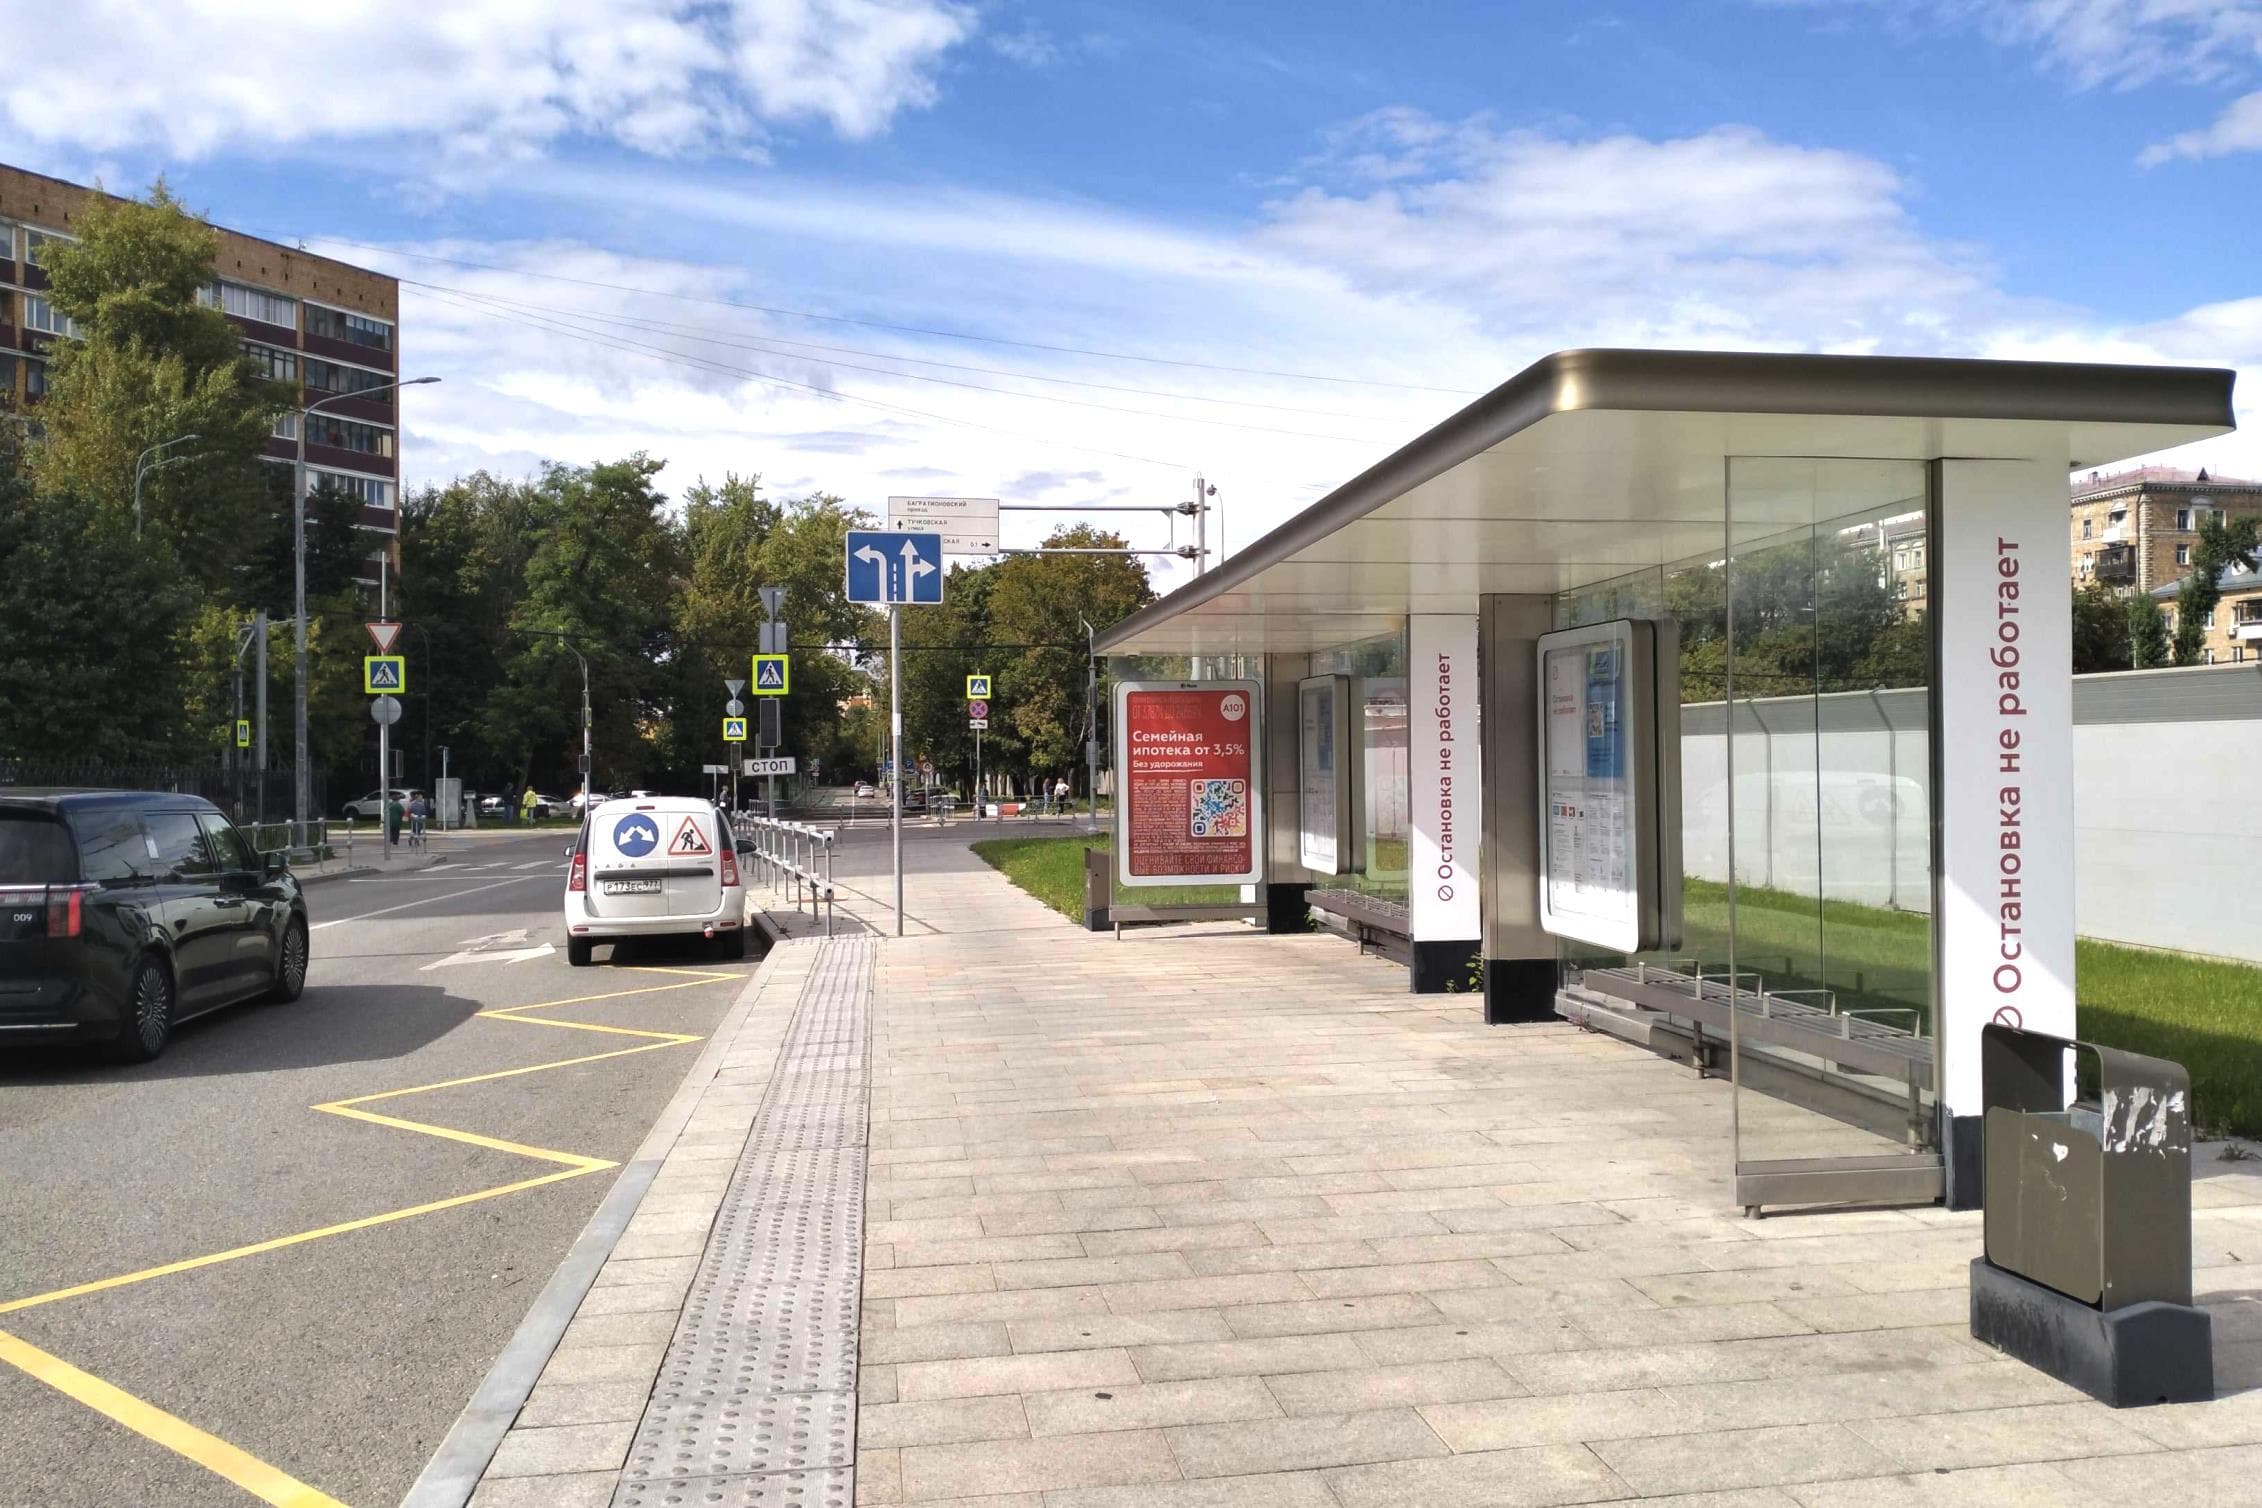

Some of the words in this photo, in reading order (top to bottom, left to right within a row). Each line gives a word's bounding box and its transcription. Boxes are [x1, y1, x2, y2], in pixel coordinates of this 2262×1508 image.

[1990, 537, 2027, 715] работает
[1435, 653, 1454, 741] работает
[1132, 730, 1203, 742] Семейная
[1132, 746, 1191, 756] ипотека
[1194, 747, 1210, 755] от
[1213, 743, 1245, 757] 3,5%
[1439, 747, 1452, 770] не
[1999, 728, 2021, 773] не
[752, 760, 788, 773] СТОП
[1133, 760, 1148, 768] Без
[1149, 761, 1203, 769] удорожания
[1438, 776, 1453, 879] Остановка
[1992, 785, 2022, 994] Остановка
[13, 913, 33, 922] 009
